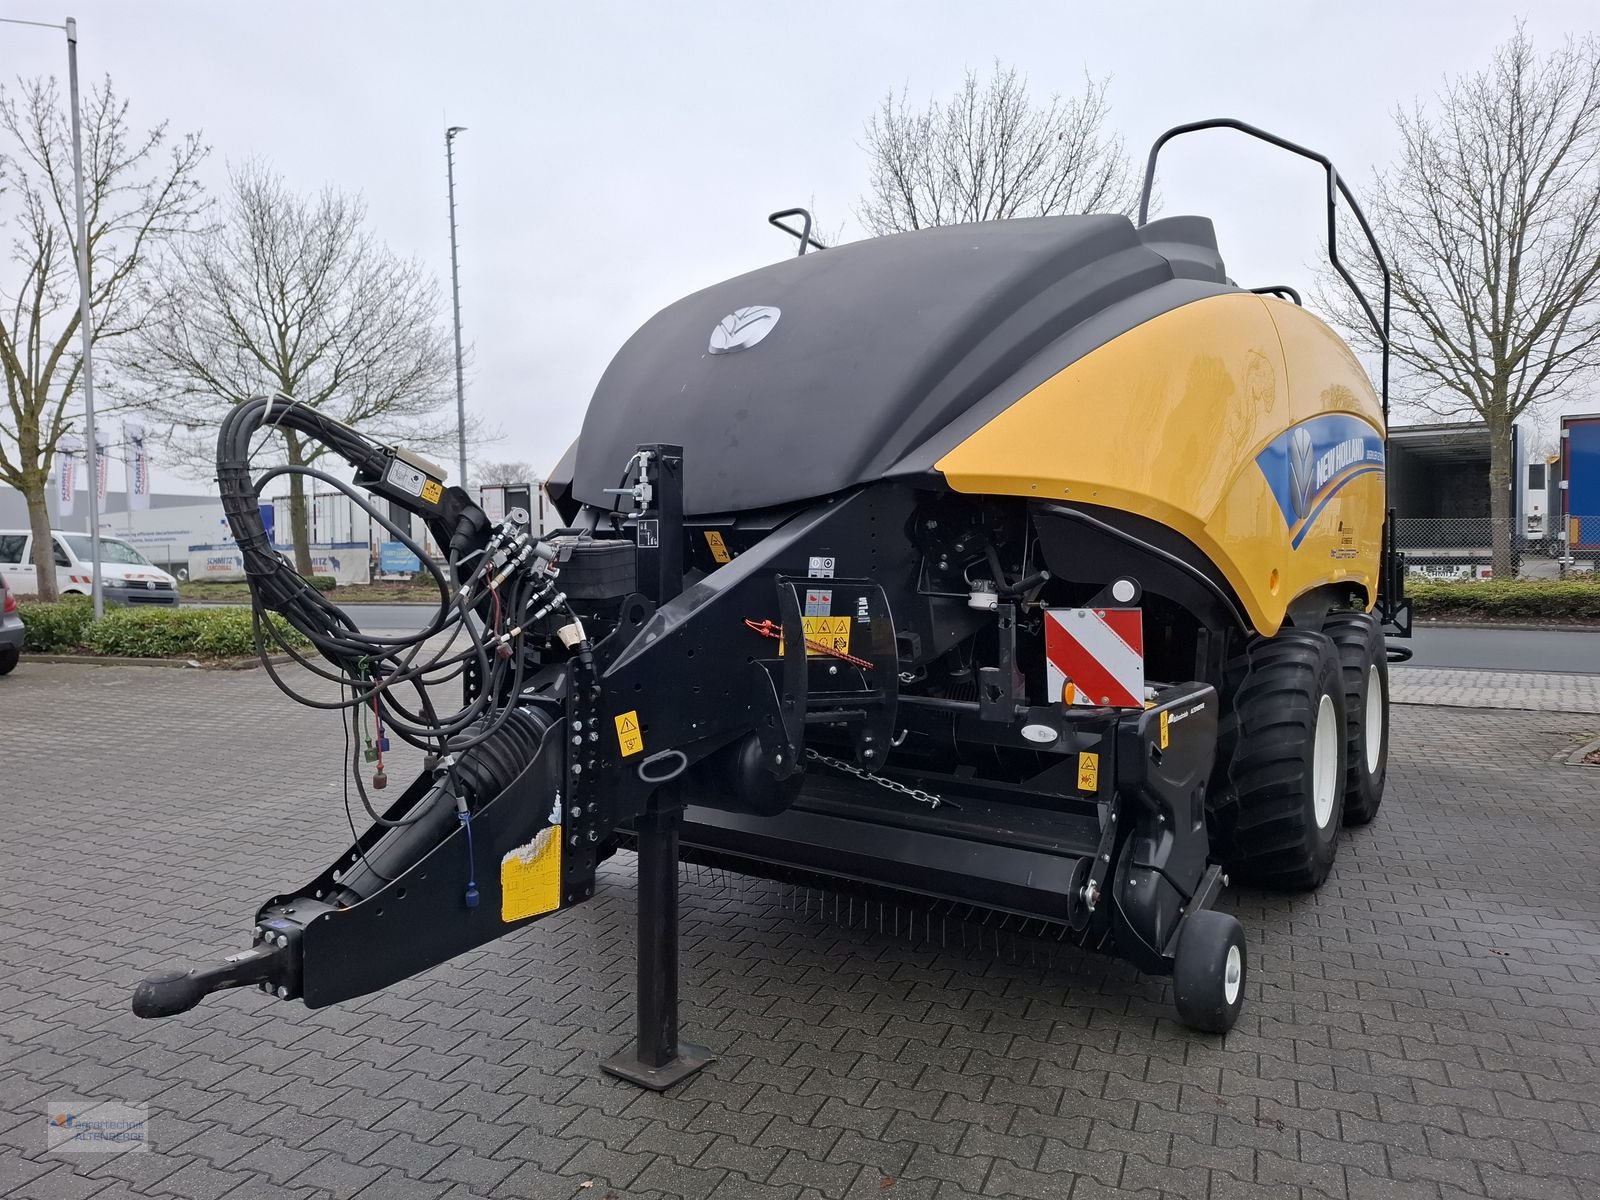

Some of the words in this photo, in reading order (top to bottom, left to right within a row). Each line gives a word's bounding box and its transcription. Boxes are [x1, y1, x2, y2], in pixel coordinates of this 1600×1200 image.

[1317, 448, 1335, 490] NEW
[1336, 438, 1364, 472] HOLLAND
[207, 557, 233, 565] SCHMITZ
